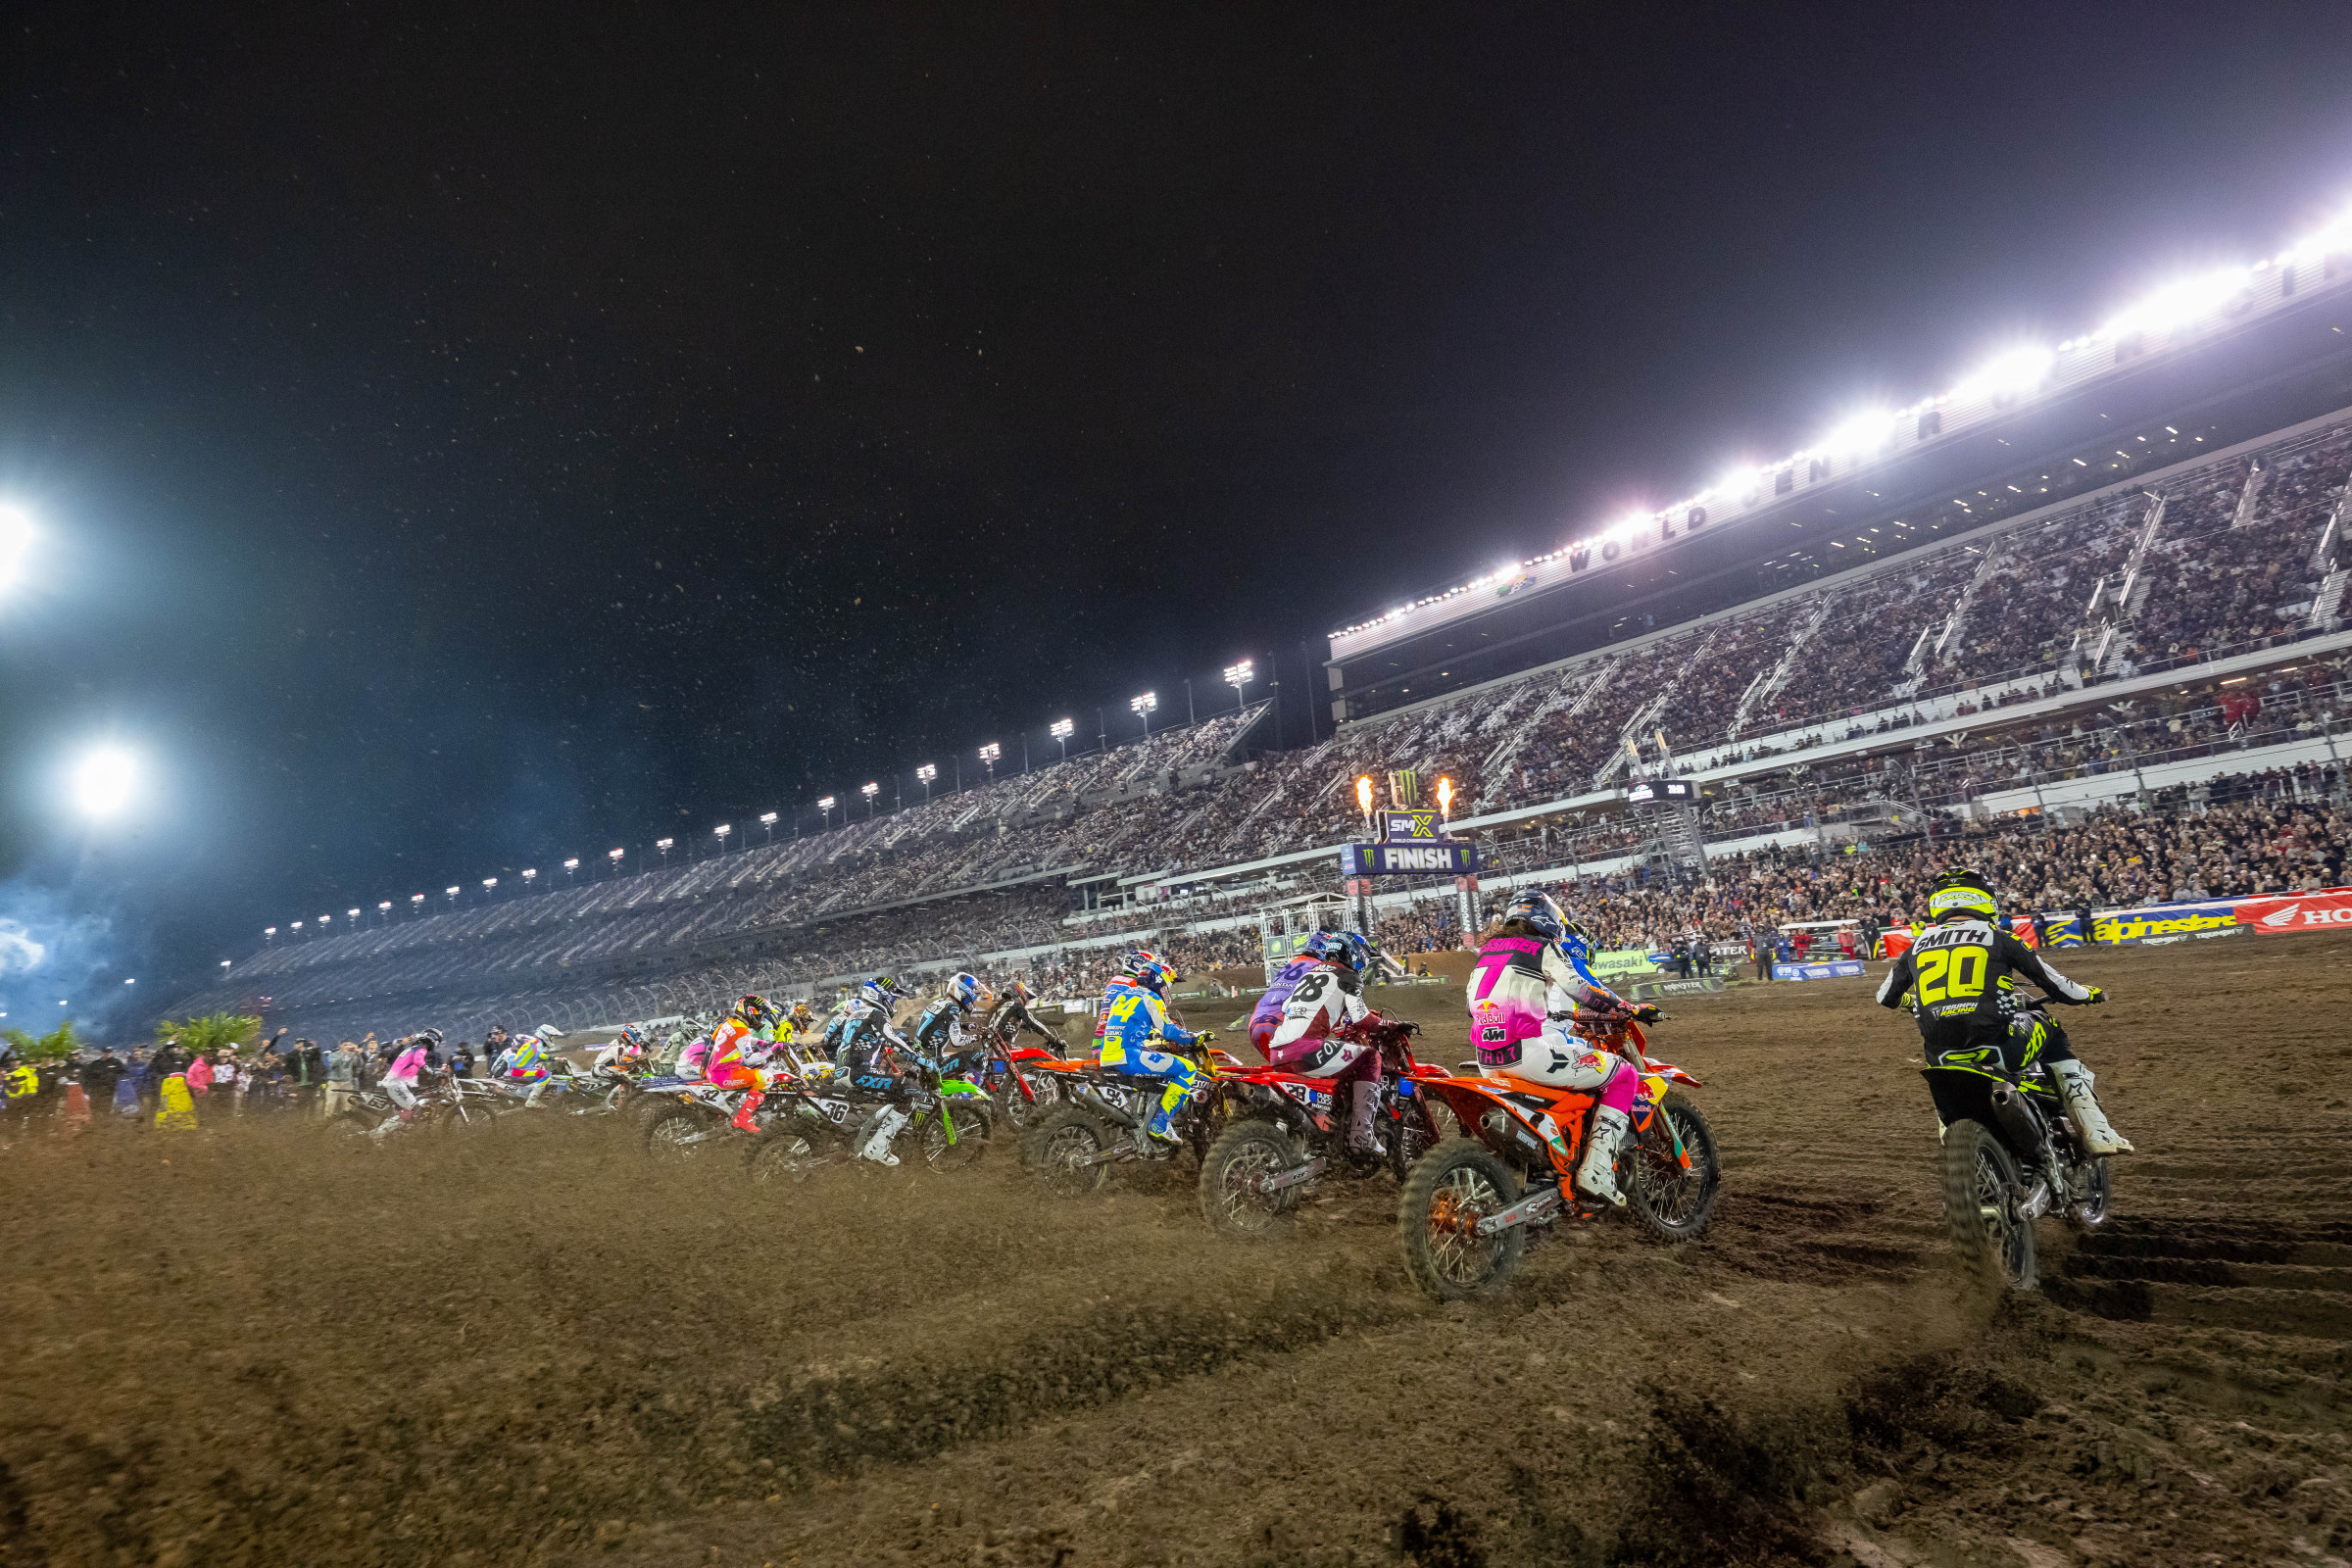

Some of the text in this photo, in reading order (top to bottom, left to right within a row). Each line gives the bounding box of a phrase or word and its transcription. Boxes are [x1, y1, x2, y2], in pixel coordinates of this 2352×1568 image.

[1384, 847, 1452, 870] FINISH
[1917, 929, 1988, 953] SMITH
[2094, 913, 2237, 946] alpinestars
[1592, 956, 1643, 970] awasaki
[1291, 973, 1323, 1003] 28
[1474, 953, 1514, 1002] 7
[1916, 946, 1989, 1006] 20
[1107, 995, 1143, 1023] 94
[1940, 1006, 1976, 1017] RACING
[1941, 1002, 1979, 1012] TRIUMPH
[1482, 1026, 1506, 1042] KTM
